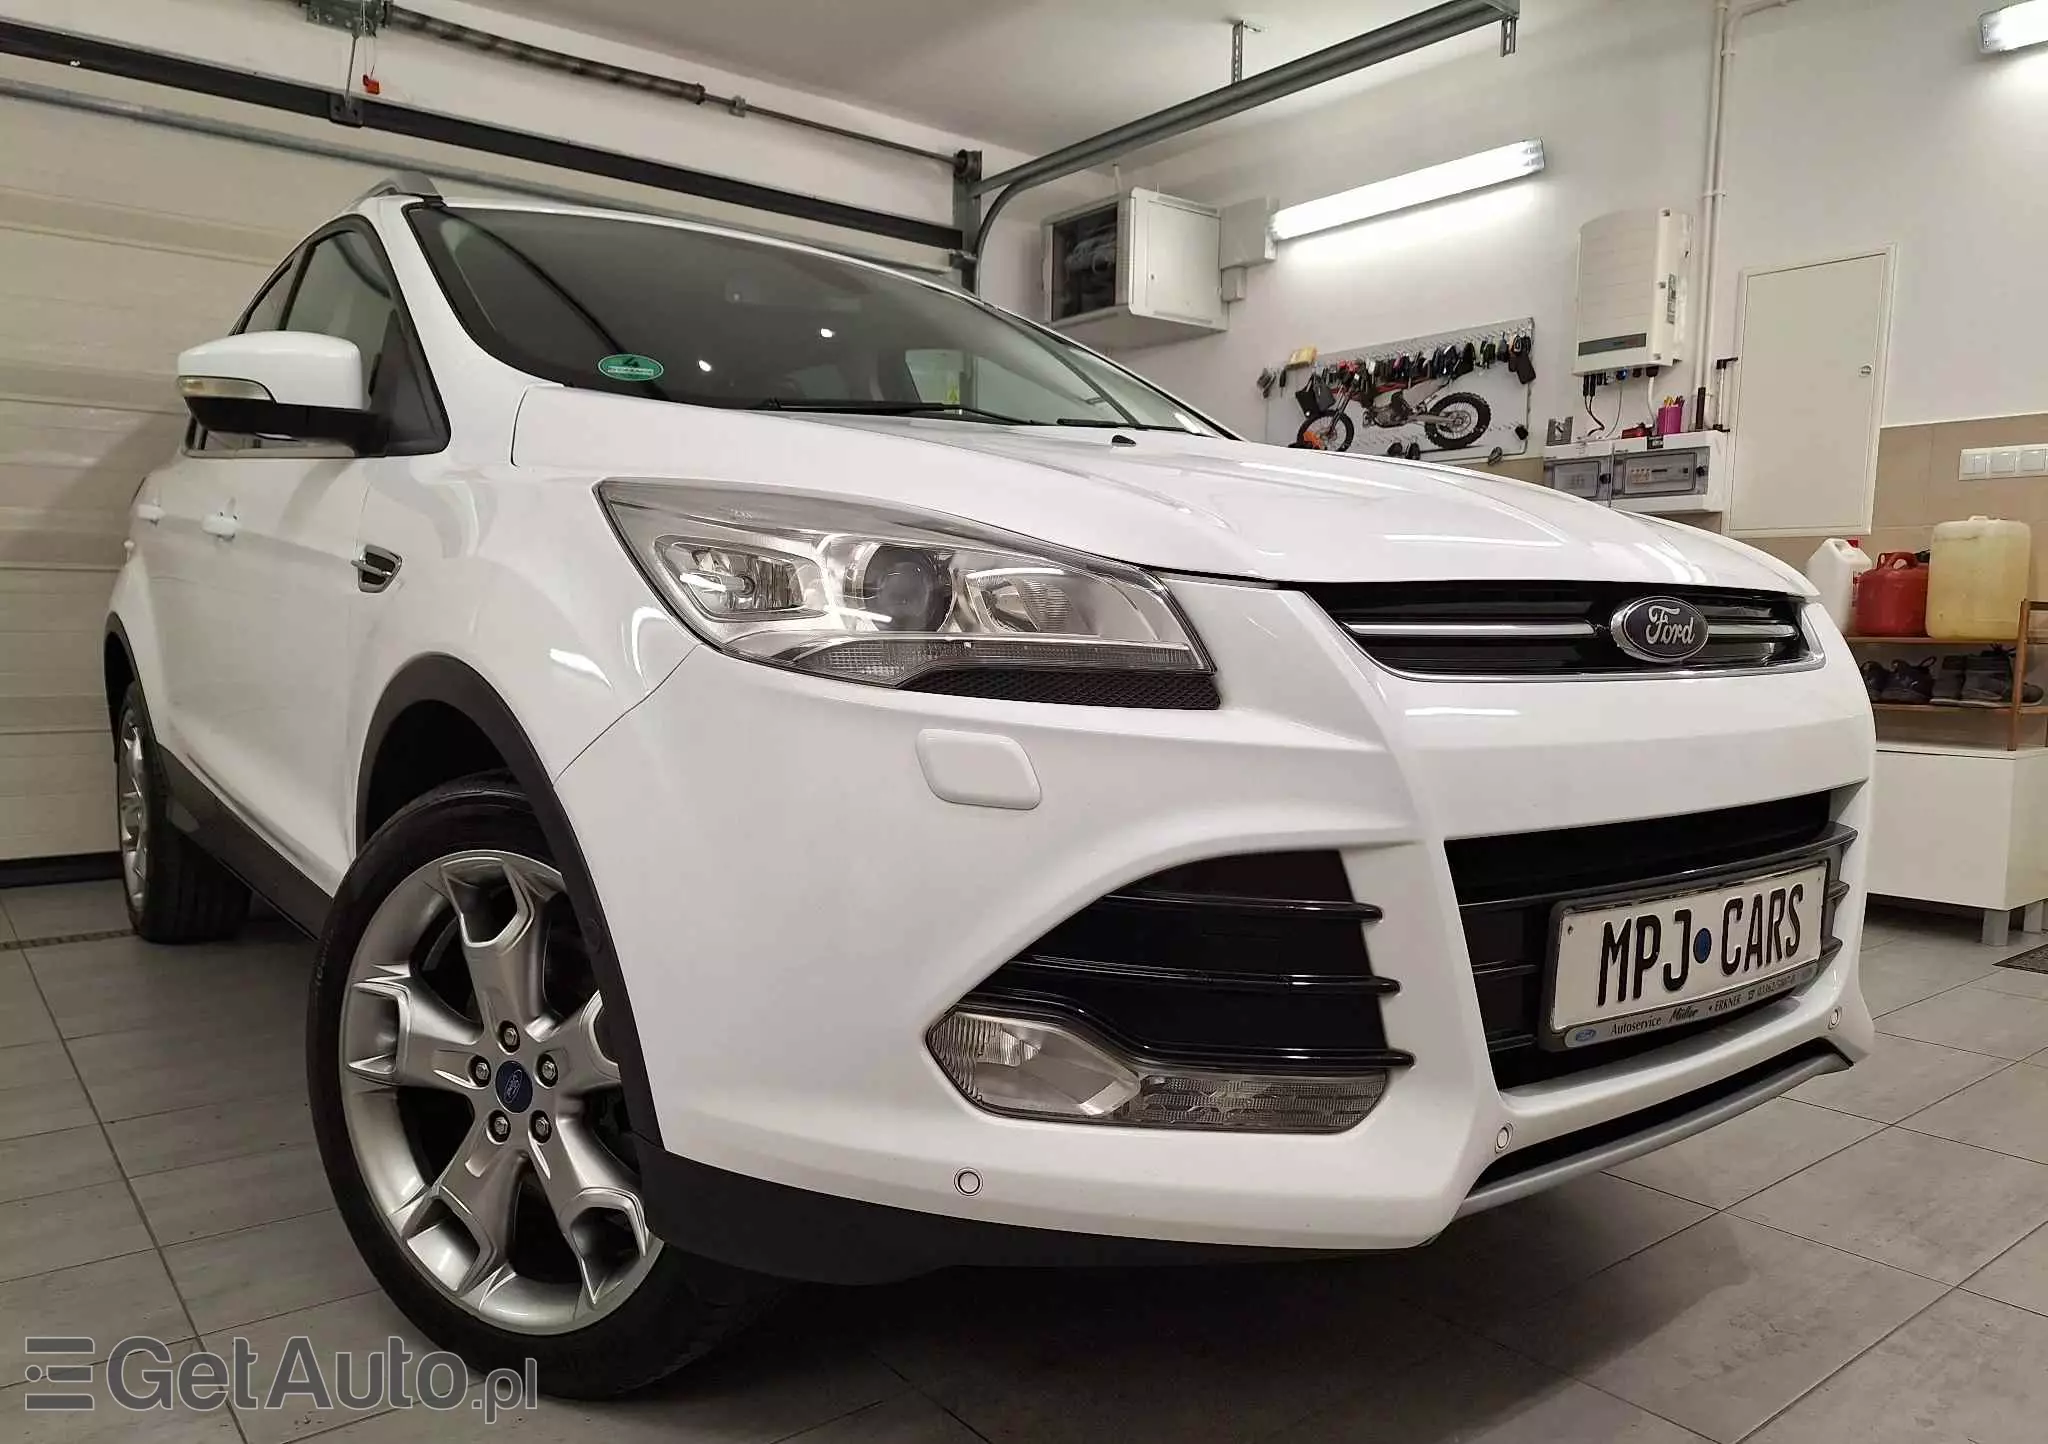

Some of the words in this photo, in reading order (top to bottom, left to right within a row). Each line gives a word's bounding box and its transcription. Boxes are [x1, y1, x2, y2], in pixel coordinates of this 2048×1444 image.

[1646, 605, 1695, 644] Ford
[1597, 908, 1692, 1007] MPJ
[1721, 883, 1803, 976] CARS
[1611, 1015, 1662, 1035] Autoservice
